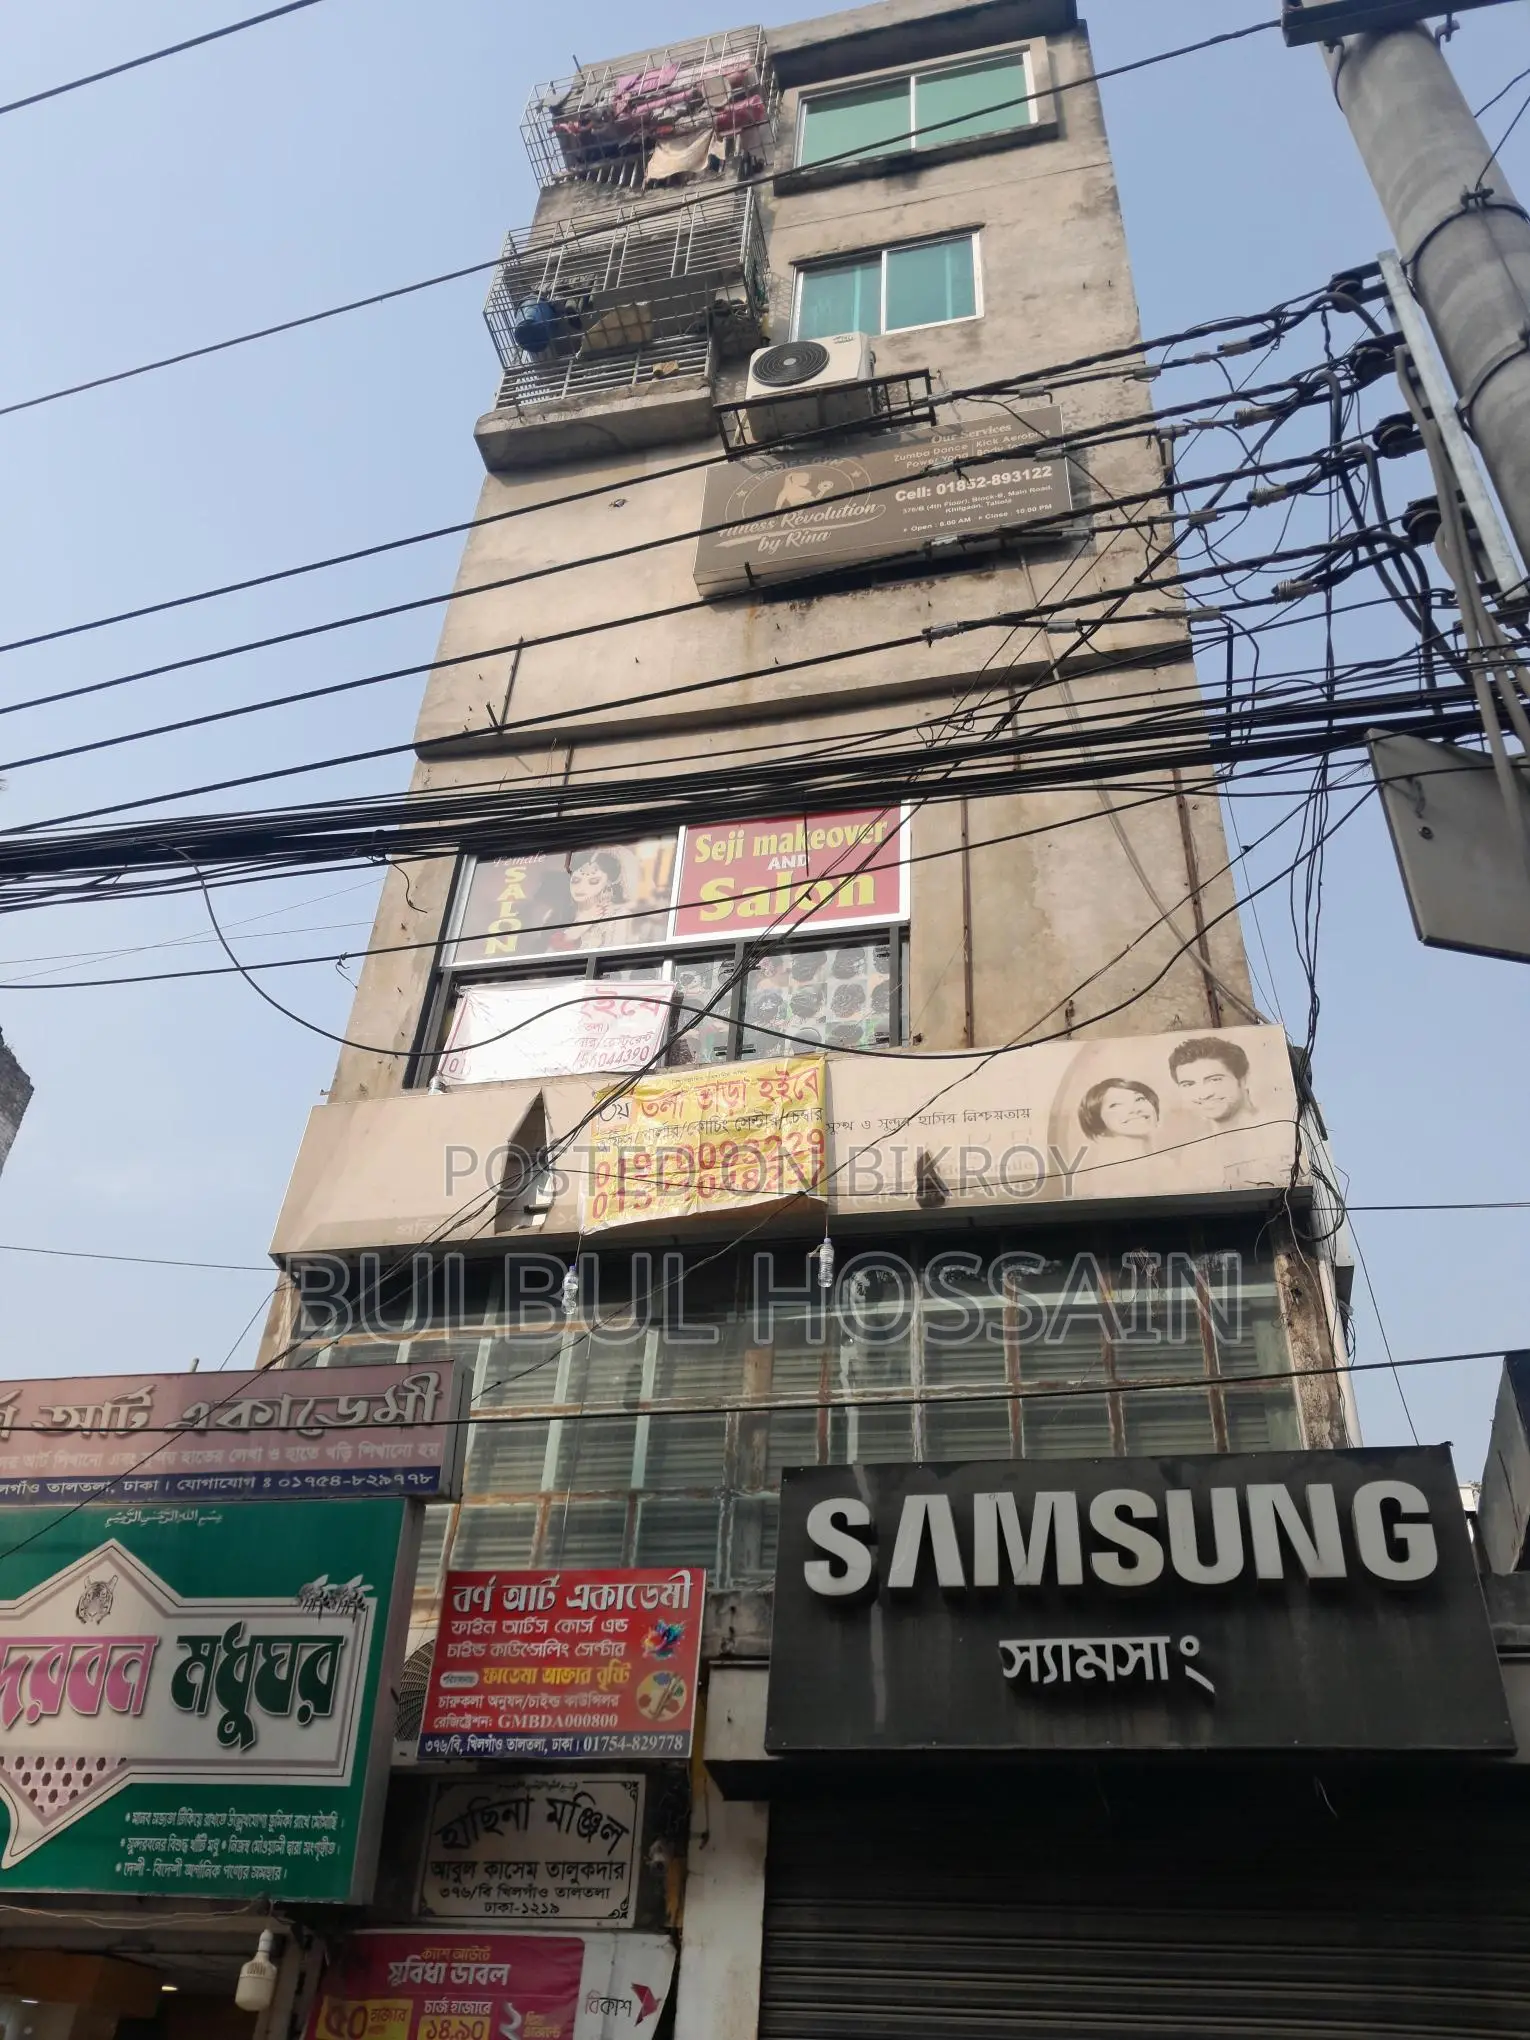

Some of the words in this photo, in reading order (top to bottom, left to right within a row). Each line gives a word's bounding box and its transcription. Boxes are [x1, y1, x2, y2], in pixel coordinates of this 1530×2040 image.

[930, 434, 957, 445] Our
[960, 424, 1012, 440] Services
[976, 438, 998, 448] Kick
[893, 451, 931, 463] Zumba
[933, 444, 968, 455] Dance
[895, 486, 931, 502] Cell:
[936, 465, 1053, 496] 01852-893122
[1008, 488, 1028, 497] Main
[779, 501, 878, 530] Revolution
[911, 523, 933, 532] Open
[958, 516, 971, 525] AM
[985, 511, 1009, 520] Close
[1039, 503, 1053, 511] PM
[757, 535, 782, 555] by
[785, 530, 832, 548] Rina
[694, 829, 745, 866] Seji
[753, 820, 889, 857] makeover
[767, 854, 810, 871] AND
[699, 870, 876, 922] Salon
[484, 866, 527, 956] SALON
[756, 1065, 820, 1106] হইবে
[861, 1120, 872, 1130] ও
[918, 1111, 958, 1126] হাসির
[31, 1384, 157, 1438] আর্ট
[164, 1371, 443, 1439] একাডেমী
[123, 1478, 159, 1494] ঢাকা
[176, 1475, 257, 1491] যোগাযোগ
[278, 1473, 434, 1489] ০১৭৫৪-৮২৯৭৭৮
[803, 1480, 1440, 1598] SAMSUNG
[451, 1574, 497, 1612] বর্ণ
[501, 1573, 562, 1612] আর্ট
[565, 1570, 694, 1612] একাডেমী
[451, 1617, 497, 1636] ফাইন
[553, 1616, 598, 1635] কোর্স
[482, 1666, 538, 1686] ফাতেমা
[541, 1666, 592, 1687] আক্তার
[596, 1659, 633, 1692] বৃষ্টি
[999, 1634, 1217, 1695] স্যামসাং
[170, 1620, 346, 1752] মধুঘর
[498, 1712, 619, 1730] GMBDA000800
[506, 1736, 549, 1756] তালতলা,
[551, 1737, 574, 1754] ঢাকা
[583, 1732, 684, 1752] 01754-829778
[434, 1794, 536, 1850] হাছিনা
[545, 1791, 631, 1857] মঞ্জিল
[430, 1861, 478, 1885] আবুল
[483, 1861, 541, 1881] কাসেম
[544, 1860, 628, 1886] তালুকদার
[439, 1882, 493, 1900] ৩৭৬/বি
[496, 1882, 549, 1900] খিলগাঁও
[554, 1886, 611, 1900] তালতলা
[483, 1901, 562, 1916] ঢাকা-১২১৯
[388, 1954, 449, 1987] সুবিধা
[450, 1962, 512, 1987] ডাবল
[423, 1995, 450, 2014] চার্জ
[584, 1989, 633, 2017] বিকাশ
